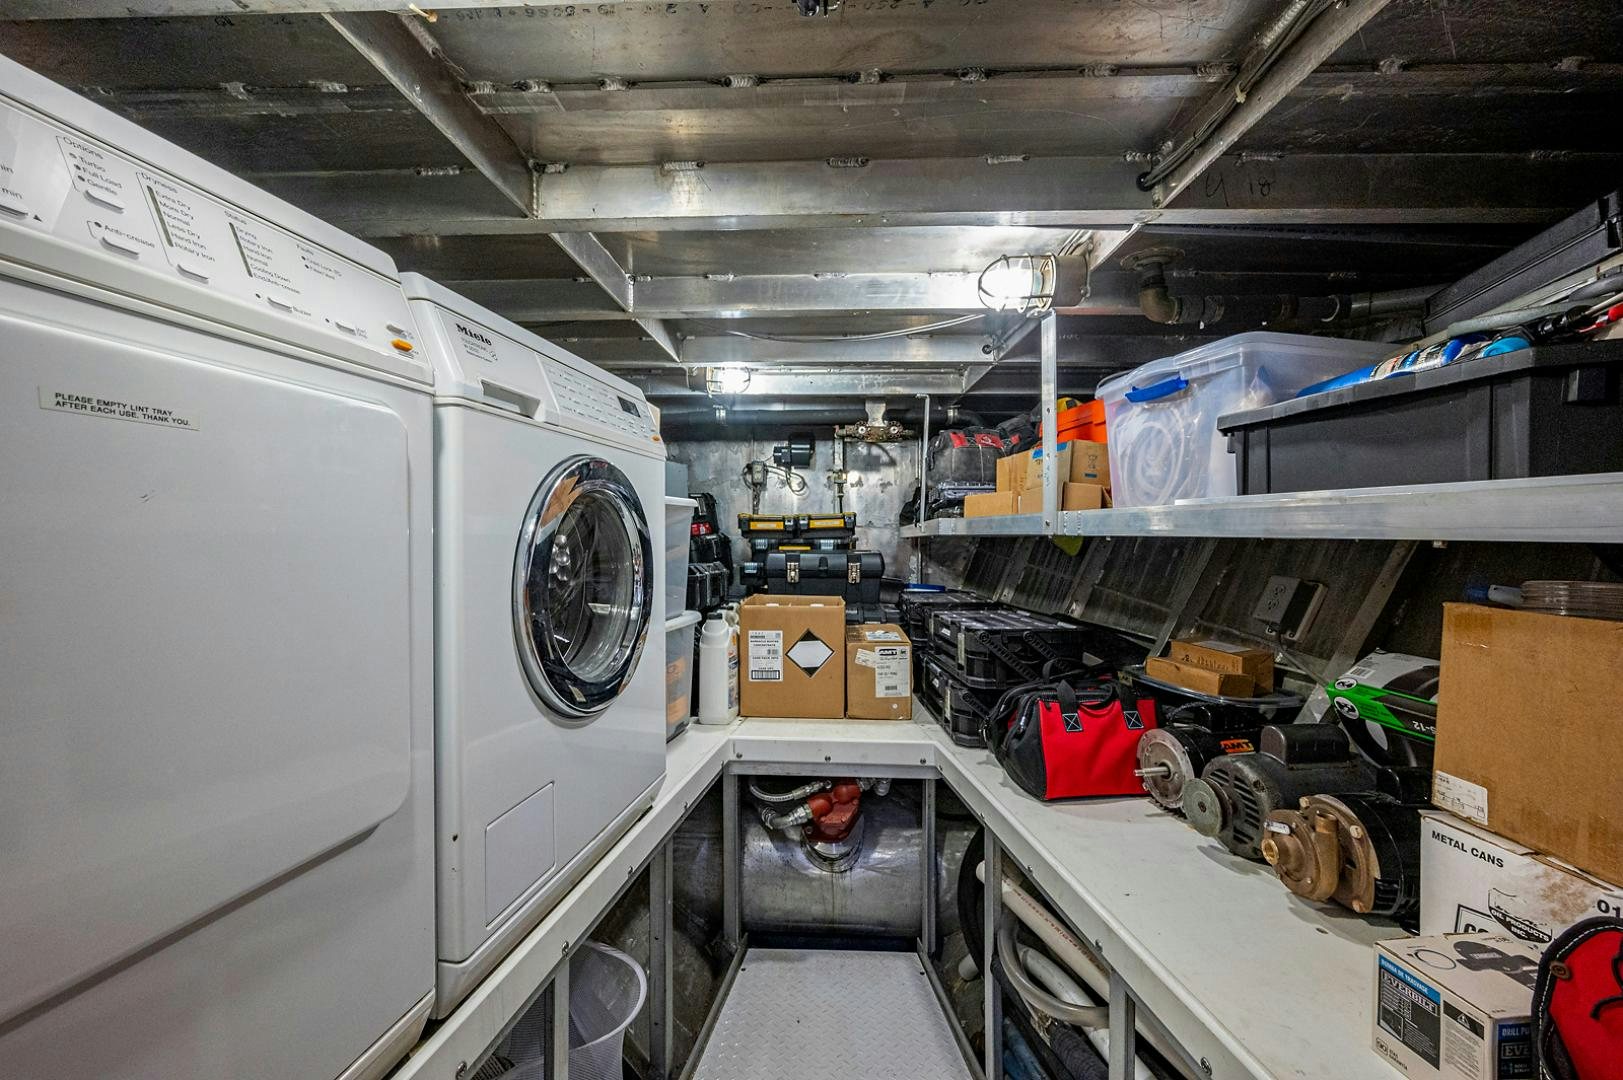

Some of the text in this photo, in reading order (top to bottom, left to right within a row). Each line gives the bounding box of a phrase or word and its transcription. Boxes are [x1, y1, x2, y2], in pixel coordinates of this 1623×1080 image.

[63, 136, 104, 159] Options
[80, 154, 106, 172] Turbo
[456, 323, 492, 346] Miele
[55, 392, 172, 417] PLEASE EMPTY LINT TRAY
[55, 400, 88, 411] AFTER
[90, 406, 116, 416] EACH
[119, 410, 139, 419] USE.
[142, 413, 169, 423] THANK
[1223, 742, 1251, 750] AMT
[1431, 829, 1505, 870] METAL CANS
[1490, 908, 1504, 921] OIL
[1506, 918, 1550, 942] PRODUCTS
[1510, 926, 1529, 939] INC.
[1383, 972, 1436, 1012] EVERBILT
[1502, 1027, 1519, 1036] DRILL
